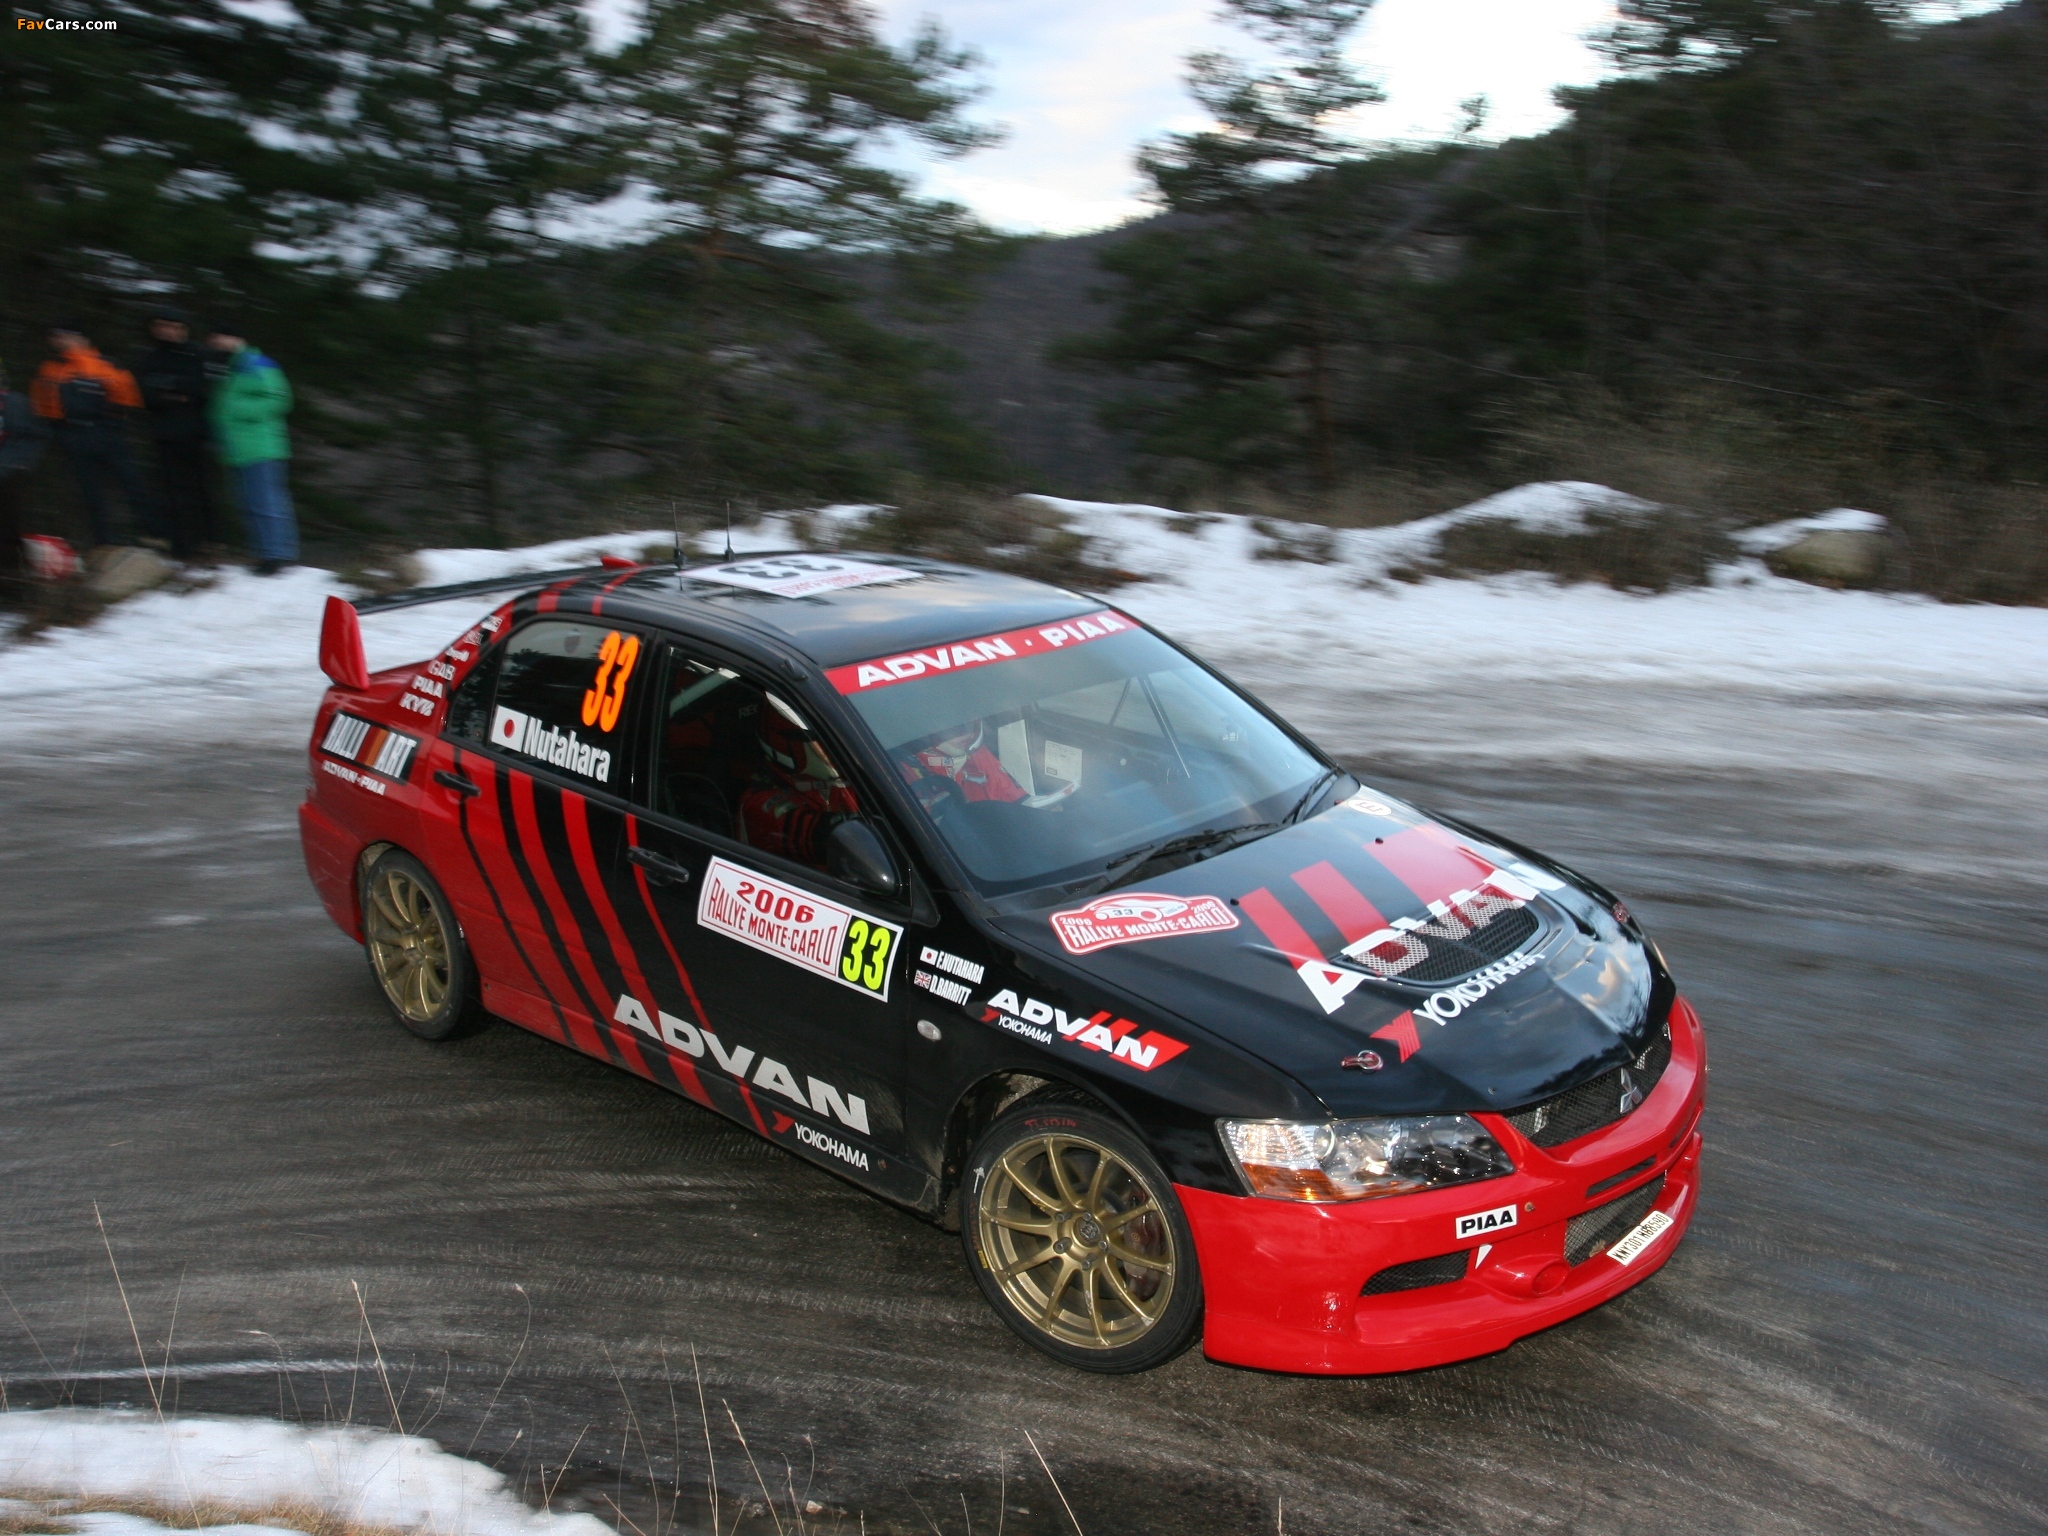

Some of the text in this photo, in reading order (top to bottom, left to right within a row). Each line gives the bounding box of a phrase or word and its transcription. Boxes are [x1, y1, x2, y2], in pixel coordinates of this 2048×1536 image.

[857, 614, 1126, 687] ADVAN PIAA
[412, 674, 444, 699] PIAA
[582, 631, 640, 733] 33
[523, 717, 611, 783] Nutahara
[706, 877, 747, 933] RALLYE
[736, 880, 816, 924] 2006
[1112, 908, 1134, 917] 33
[842, 920, 891, 991] 33
[1064, 923, 1125, 948] RALLYE
[987, 988, 1159, 1068] ADVAN
[997, 1014, 1053, 1045] YOKOHAMA
[613, 994, 871, 1135] ADVAN
[795, 1121, 870, 1172] YOKOHAMA
[1460, 1209, 1514, 1235] PIAA
